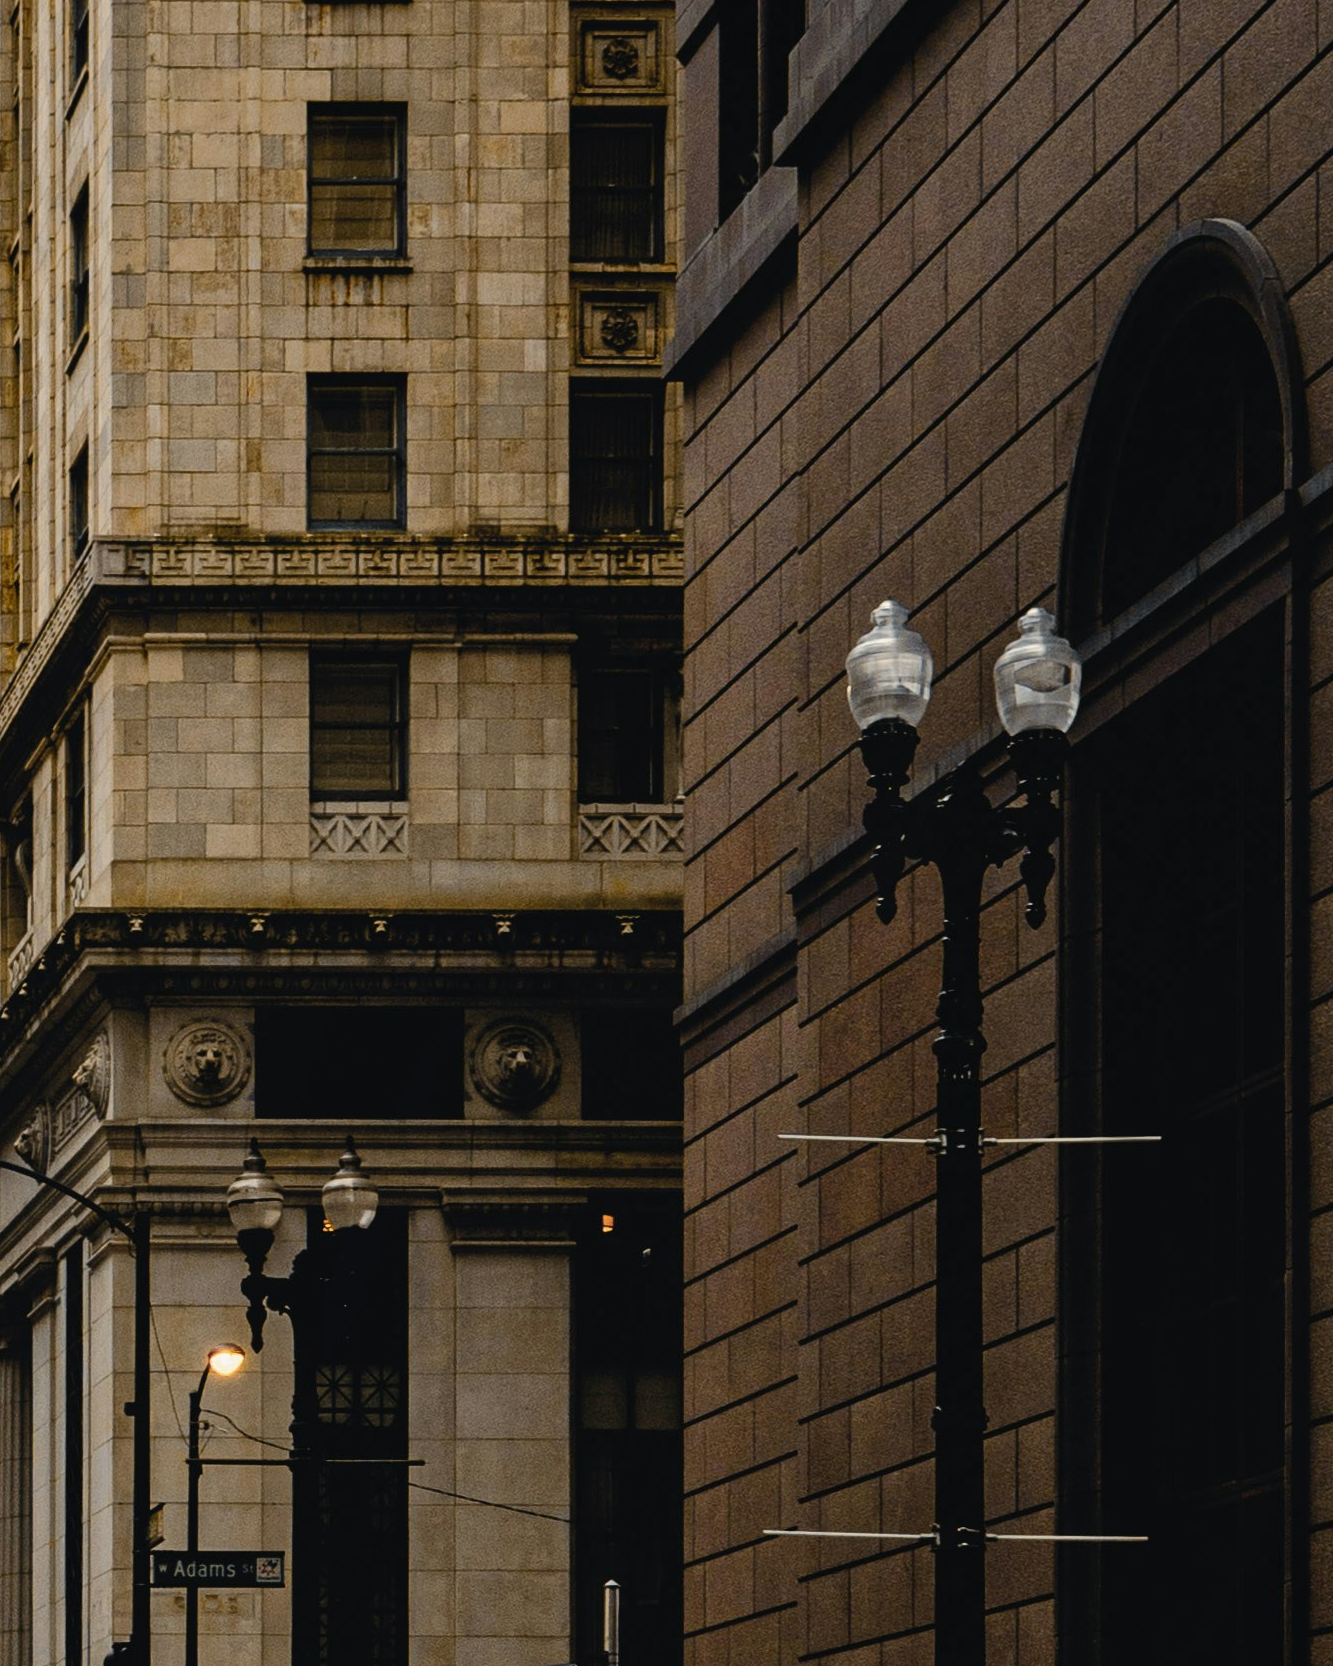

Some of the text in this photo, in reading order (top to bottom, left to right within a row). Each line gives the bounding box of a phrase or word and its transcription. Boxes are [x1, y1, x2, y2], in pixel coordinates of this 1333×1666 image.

[159, 1560, 254, 1578] W Adams St
